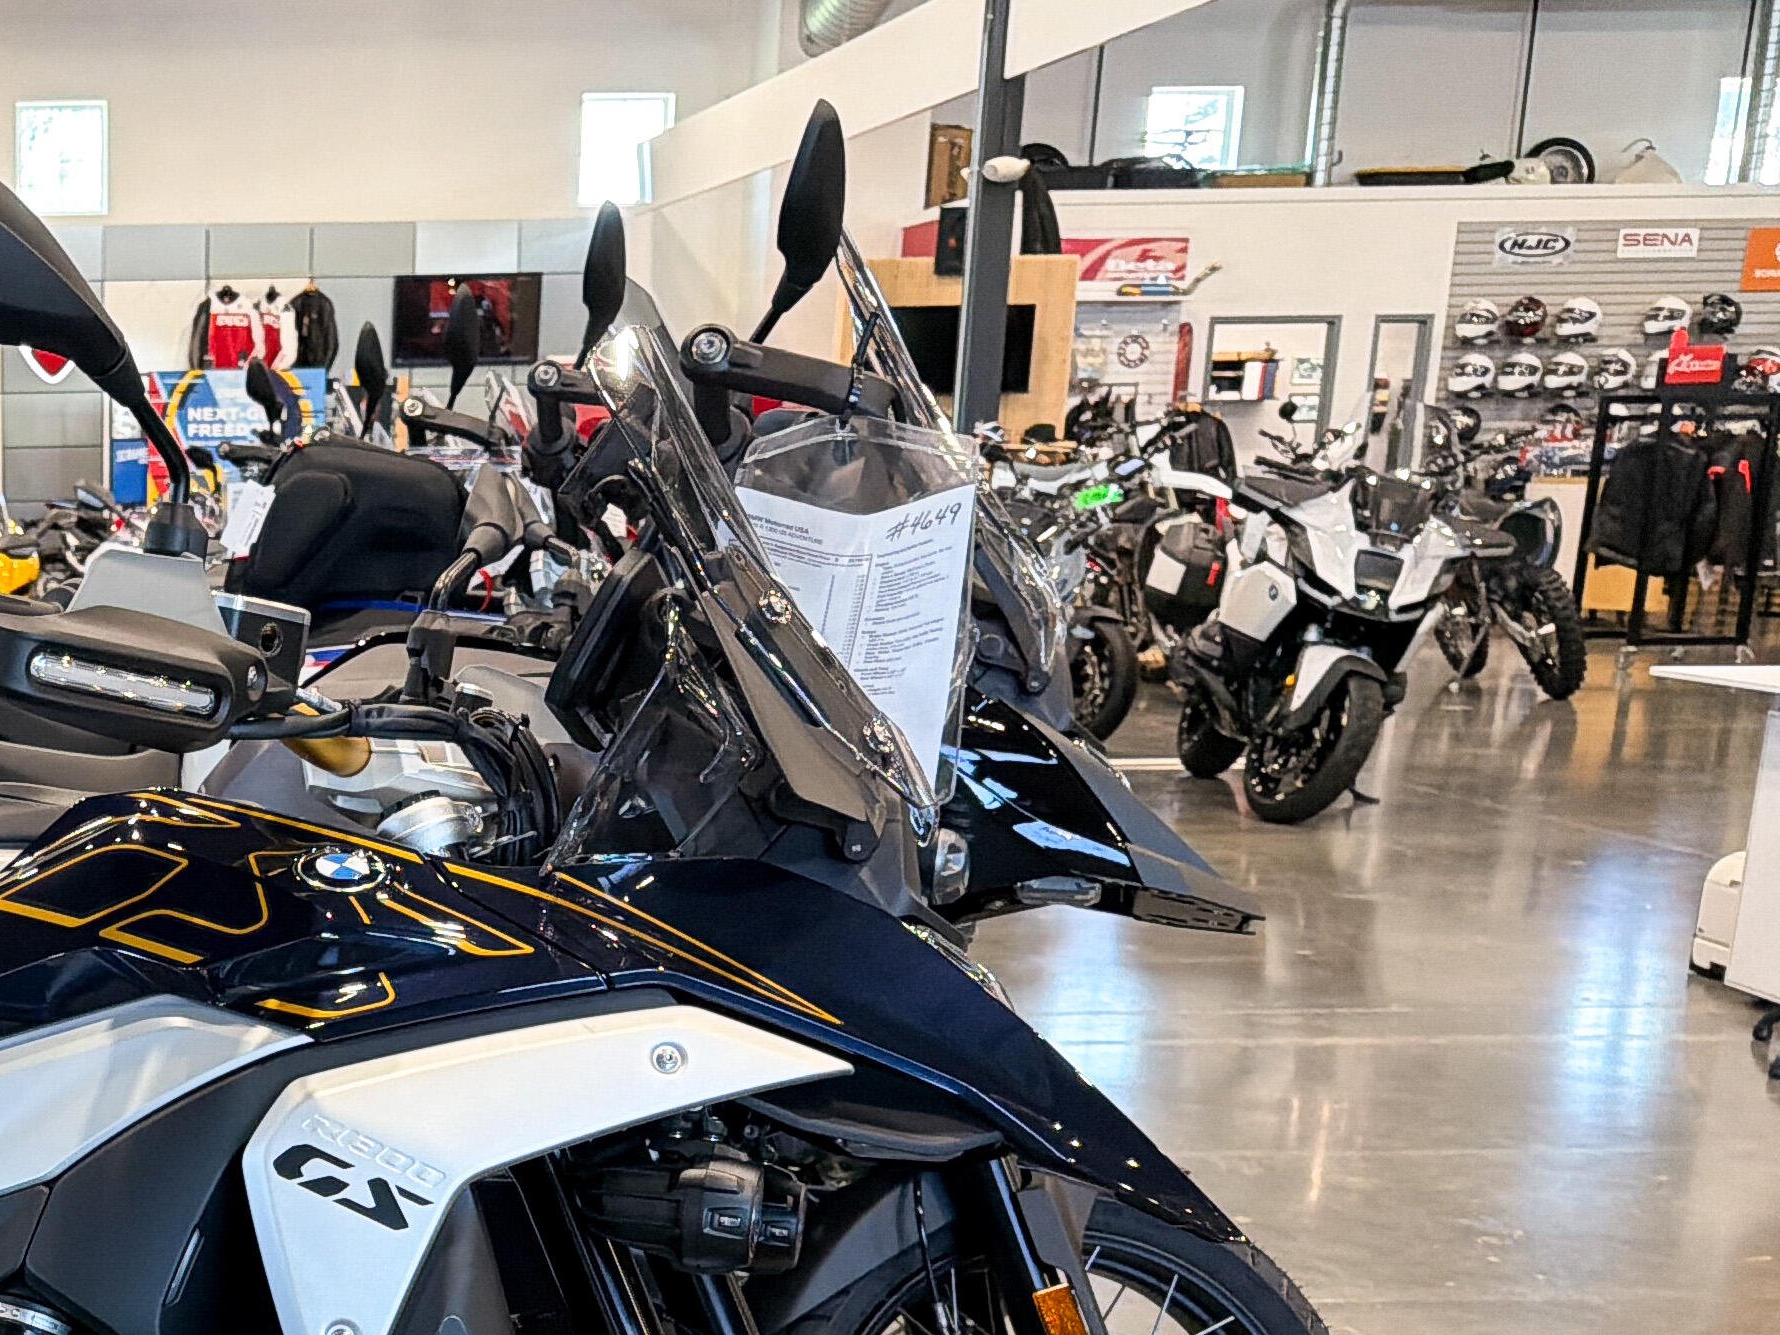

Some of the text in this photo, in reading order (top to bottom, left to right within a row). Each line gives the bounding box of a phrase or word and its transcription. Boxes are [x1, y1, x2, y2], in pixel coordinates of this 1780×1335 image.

[1622, 233, 1694, 247] SENA
[187, 407, 287, 421] NEXT-G
[885, 502, 962, 542] #4649
[272, 1142, 435, 1232] GS
